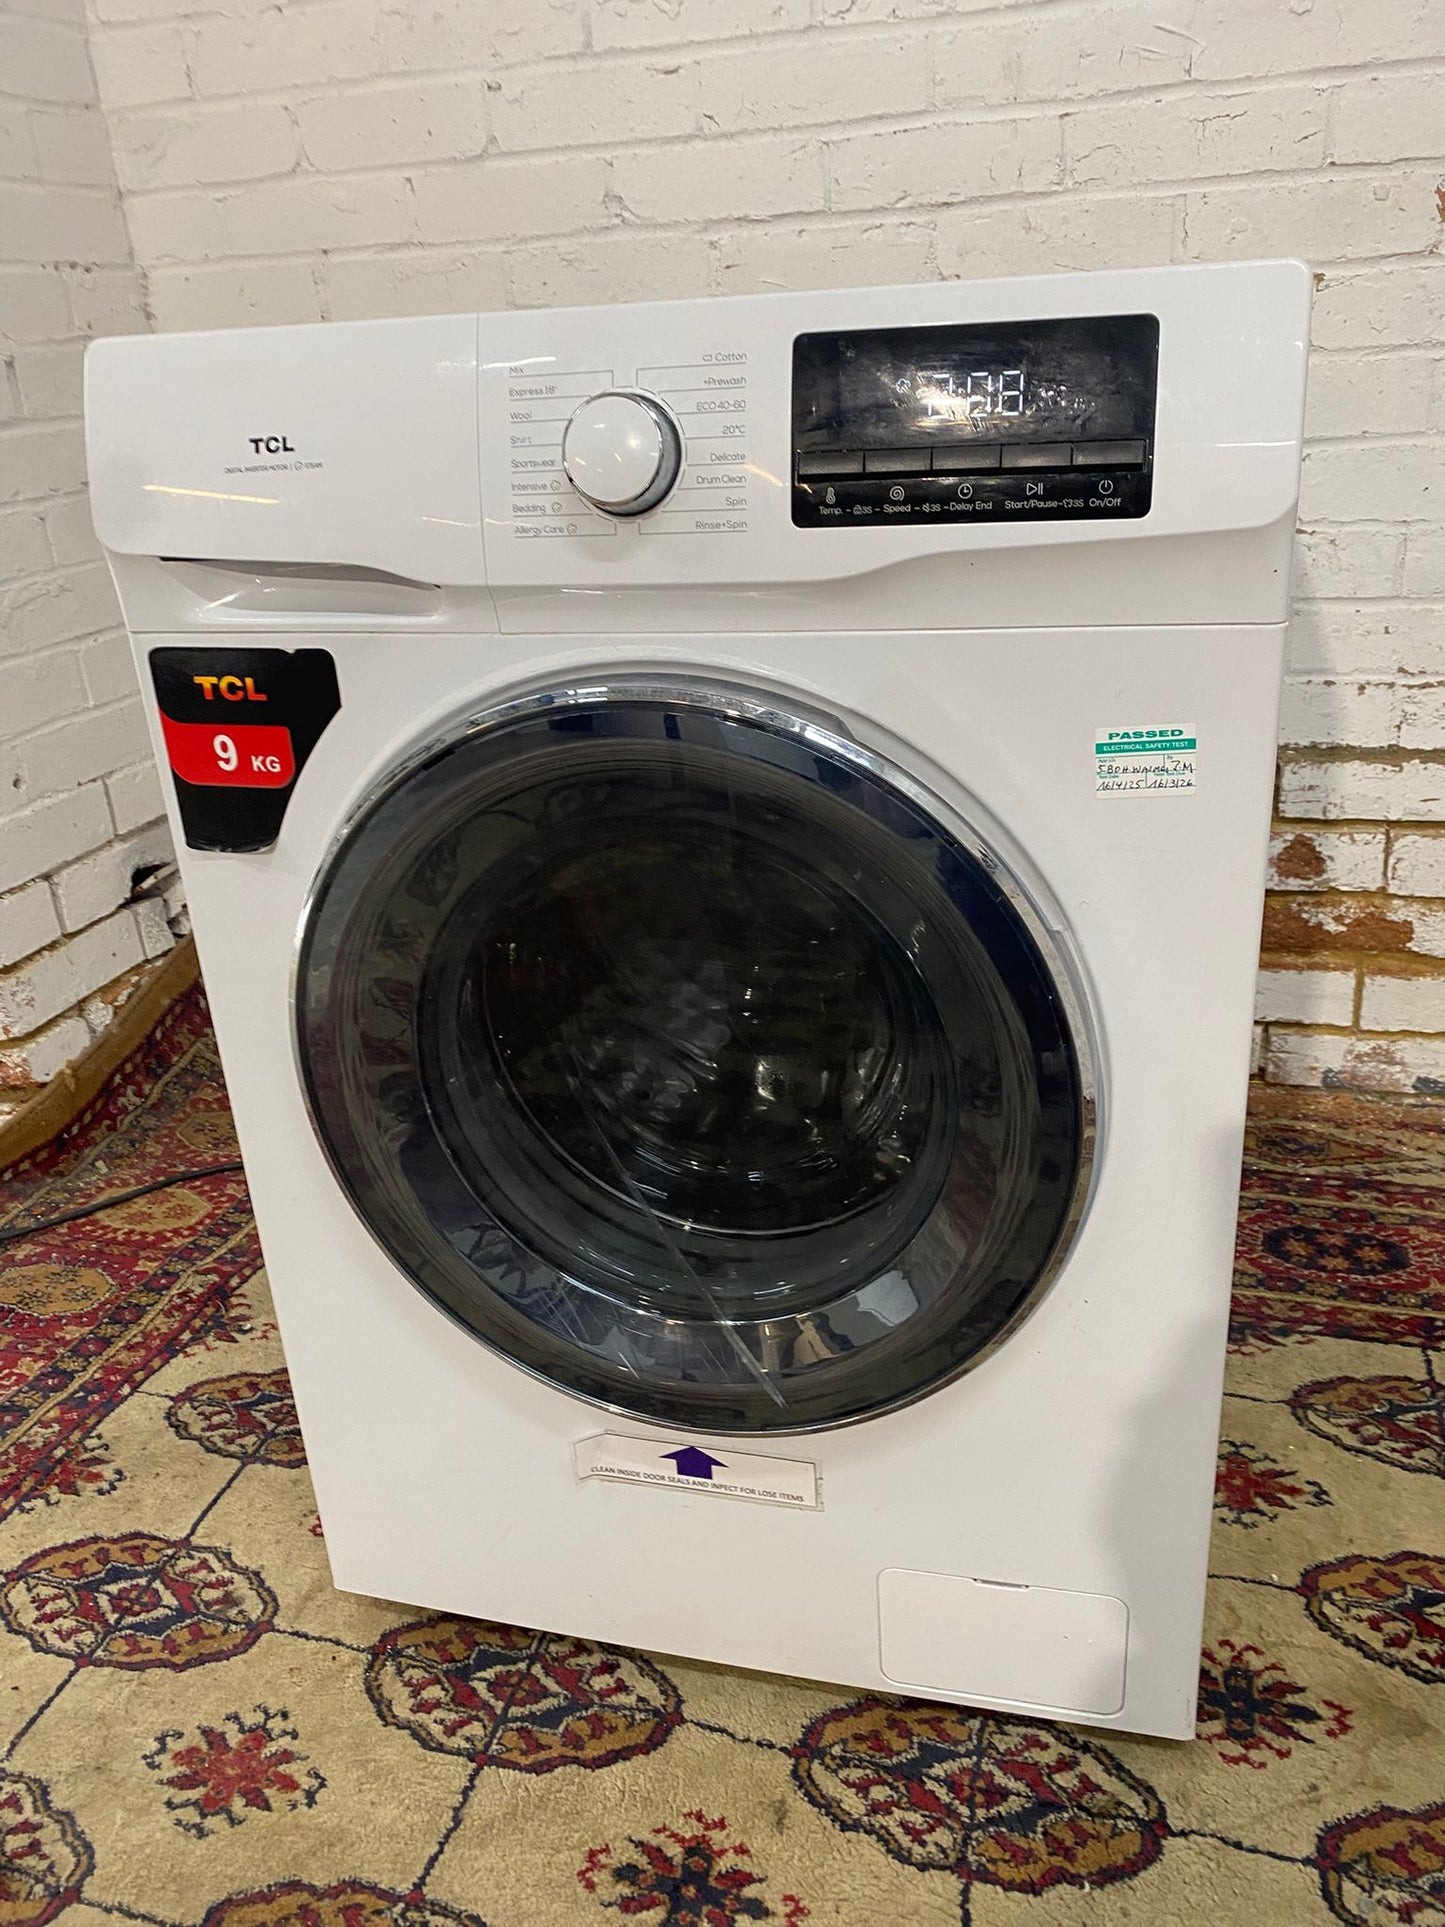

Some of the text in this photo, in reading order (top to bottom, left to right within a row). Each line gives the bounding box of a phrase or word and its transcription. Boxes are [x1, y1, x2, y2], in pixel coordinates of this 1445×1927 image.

[715, 352, 747, 362] Cotton
[508, 386, 544, 398] Express
[696, 399, 746, 411] ECO 40-60
[509, 410, 532, 420] Wool
[248, 435, 295, 454] TCL
[509, 435, 532, 445] Shirt
[710, 452, 746, 462] Delicate
[510, 459, 556, 469] Sportswear
[696, 474, 747, 485] Drum Clean
[511, 481, 548, 491] Intensive
[725, 496, 747, 507] Spin
[883, 503, 911, 515] Speed
[950, 501, 974, 512] Delay
[975, 500, 993, 510] End
[1088, 497, 1122, 508] On/Off
[512, 503, 546, 514] Bedding
[514, 524, 565, 537] Allergy Care
[193, 674, 268, 701] TCL
[1108, 729, 1184, 740] PASSED
[1103, 743, 1143, 752] ELECTRICAL
[1145, 742, 1170, 750] SAFETY
[213, 733, 282, 773] 9 KG
[591, 1465, 616, 1474] CLEAN
[616, 1468, 642, 1477] INSIDE
[643, 1472, 666, 1481] DOOR
[667, 1476, 690, 1485] SEALS
[711, 1482, 738, 1492] INPECT
[740, 1487, 756, 1495] FOR
[758, 1490, 777, 1498] LOSE
